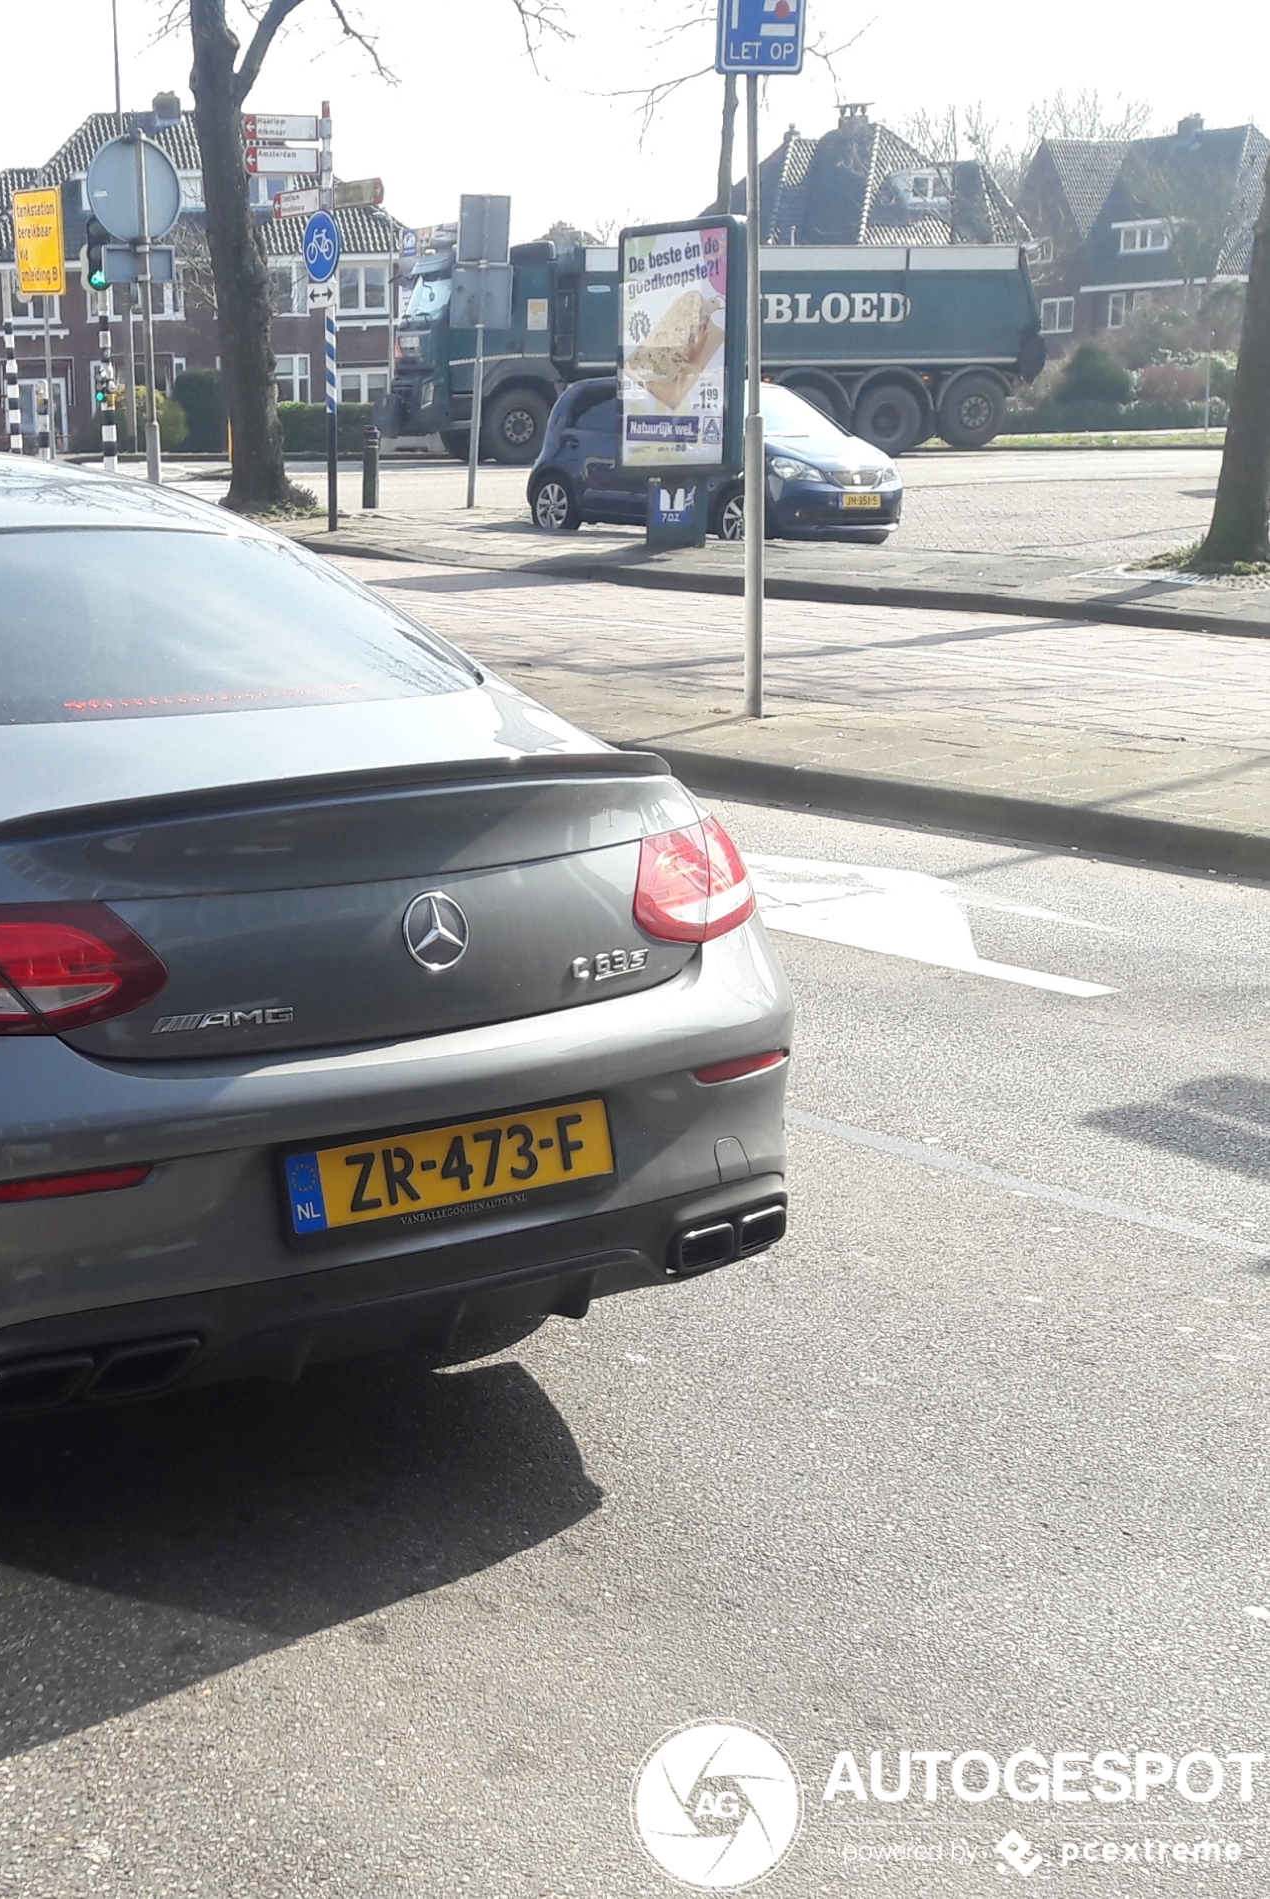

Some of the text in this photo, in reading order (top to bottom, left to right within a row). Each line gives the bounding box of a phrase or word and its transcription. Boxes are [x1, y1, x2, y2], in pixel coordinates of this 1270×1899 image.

[730, 41, 794, 60] LET OP
[257, 117, 286, 125] Haarlem
[258, 128, 286, 136] Alkmaar
[258, 150, 297, 158] Amsterdam
[16, 202, 54, 218] tankstation
[18, 224, 52, 239] bereikbaar
[19, 247, 29, 260] via
[628, 236, 719, 274] De beste én de
[22, 266, 58, 285] omleiding B
[628, 259, 720, 300] goedkoopste?!
[630, 421, 695, 438] Natuurlijk wel.
[197, 1006, 294, 1029] AMG
[297, 1113, 584, 1221] NL ZR-473-F
